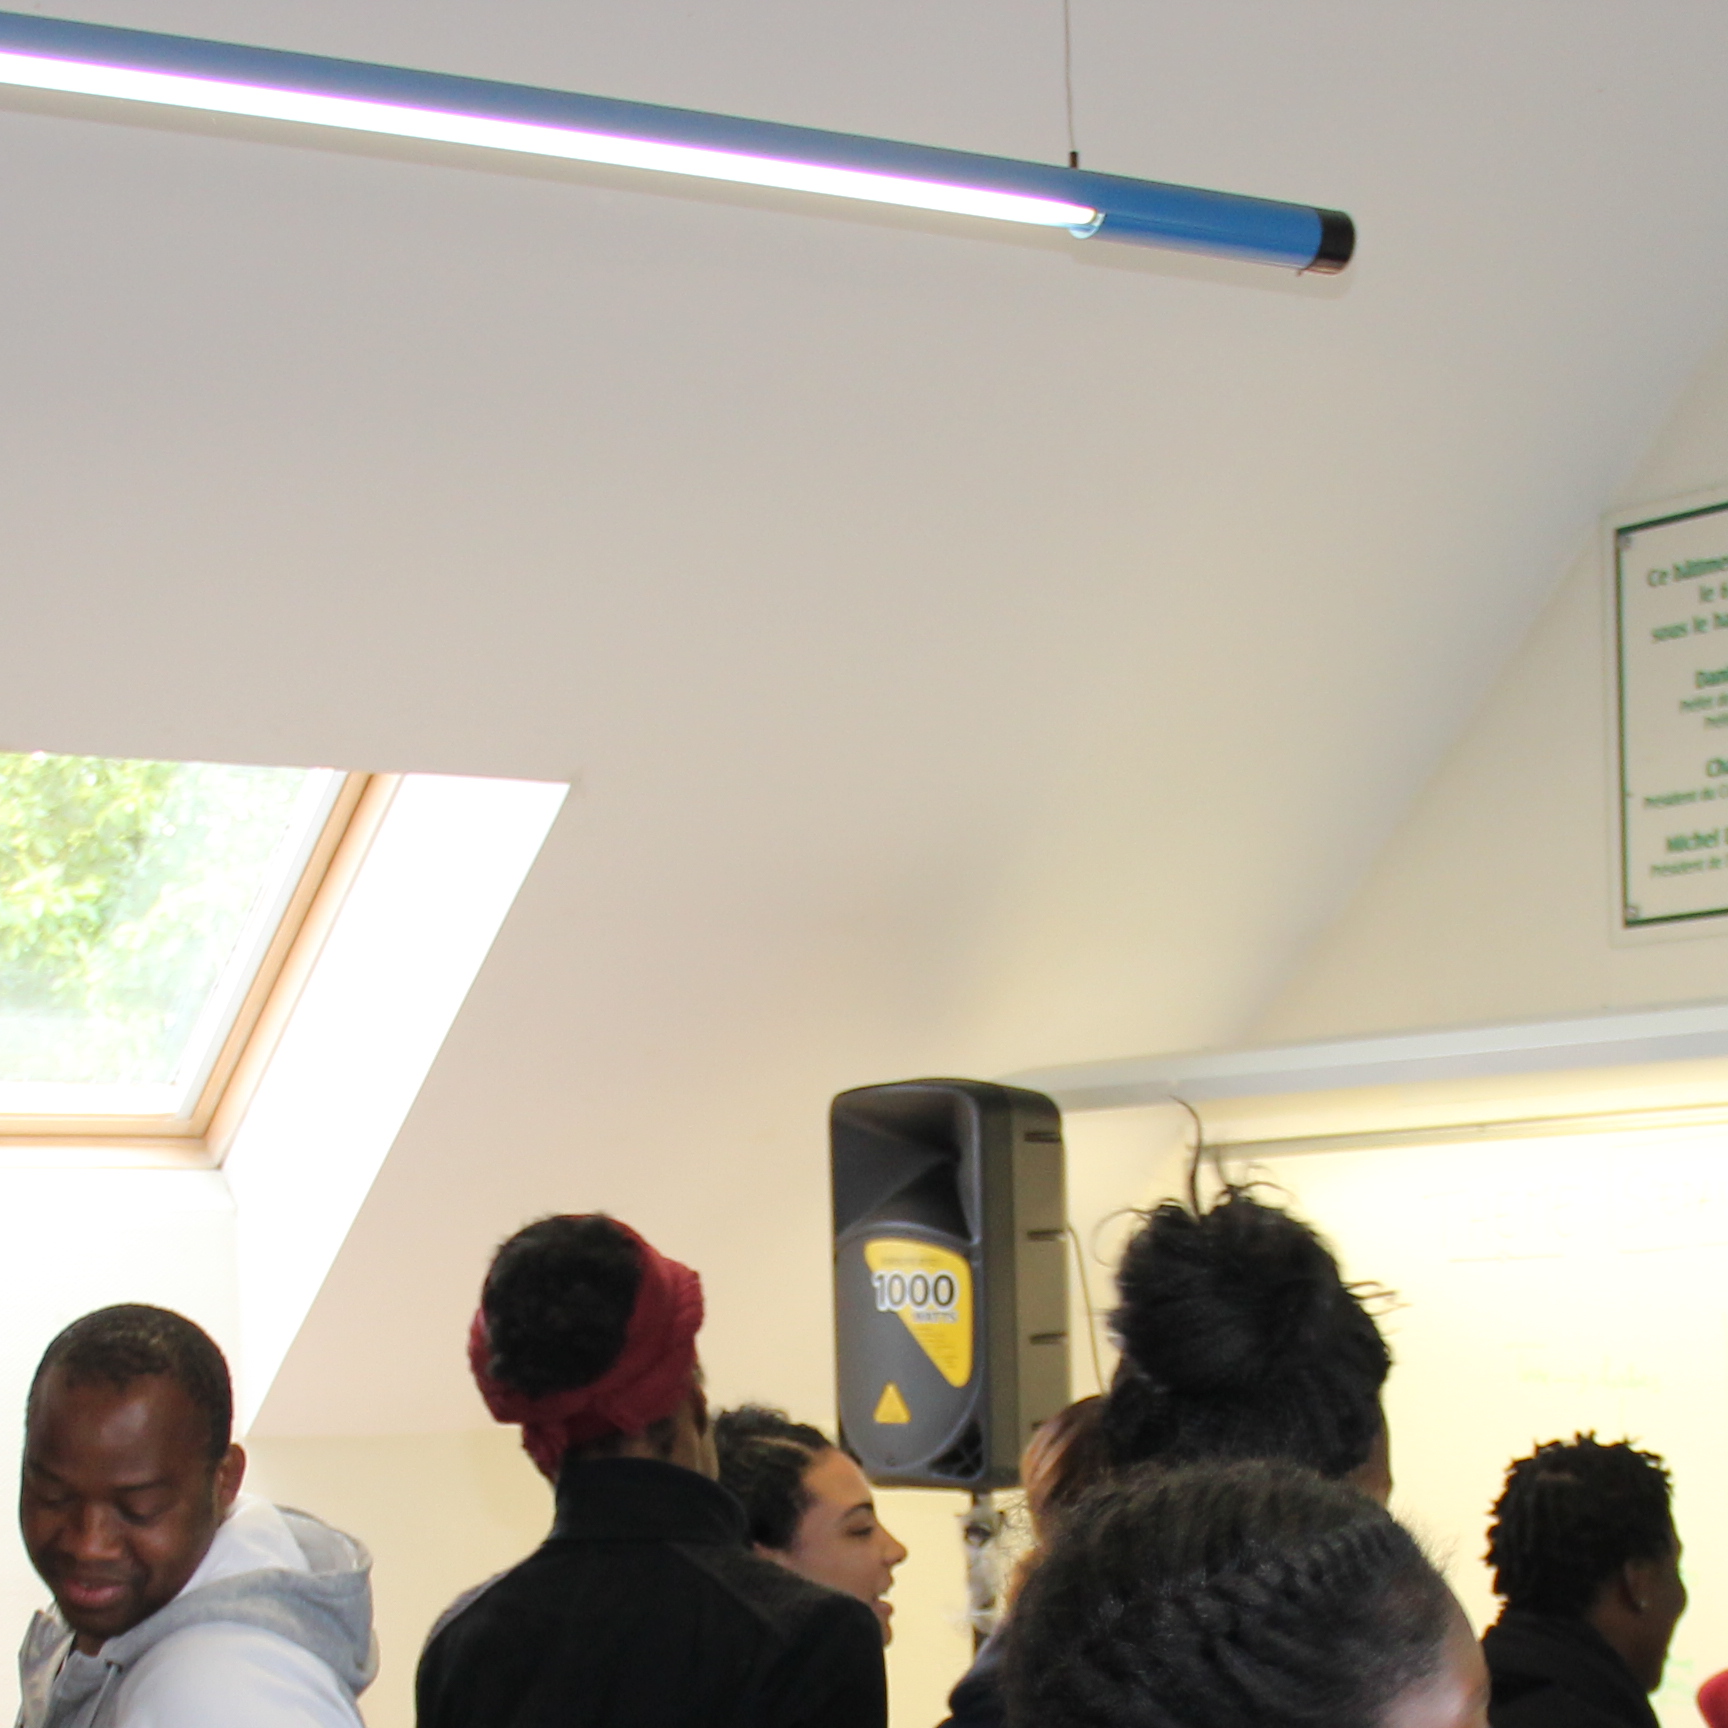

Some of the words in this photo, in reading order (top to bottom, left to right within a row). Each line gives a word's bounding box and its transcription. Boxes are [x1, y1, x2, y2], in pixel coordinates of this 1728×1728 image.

[1647, 568, 1669, 587] Ce
[1699, 583, 1715, 602] le
[1652, 622, 1689, 643] sous
[1693, 614, 1708, 634] le
[1666, 827, 1719, 853] Michel
[873, 1270, 958, 1310] 1000
